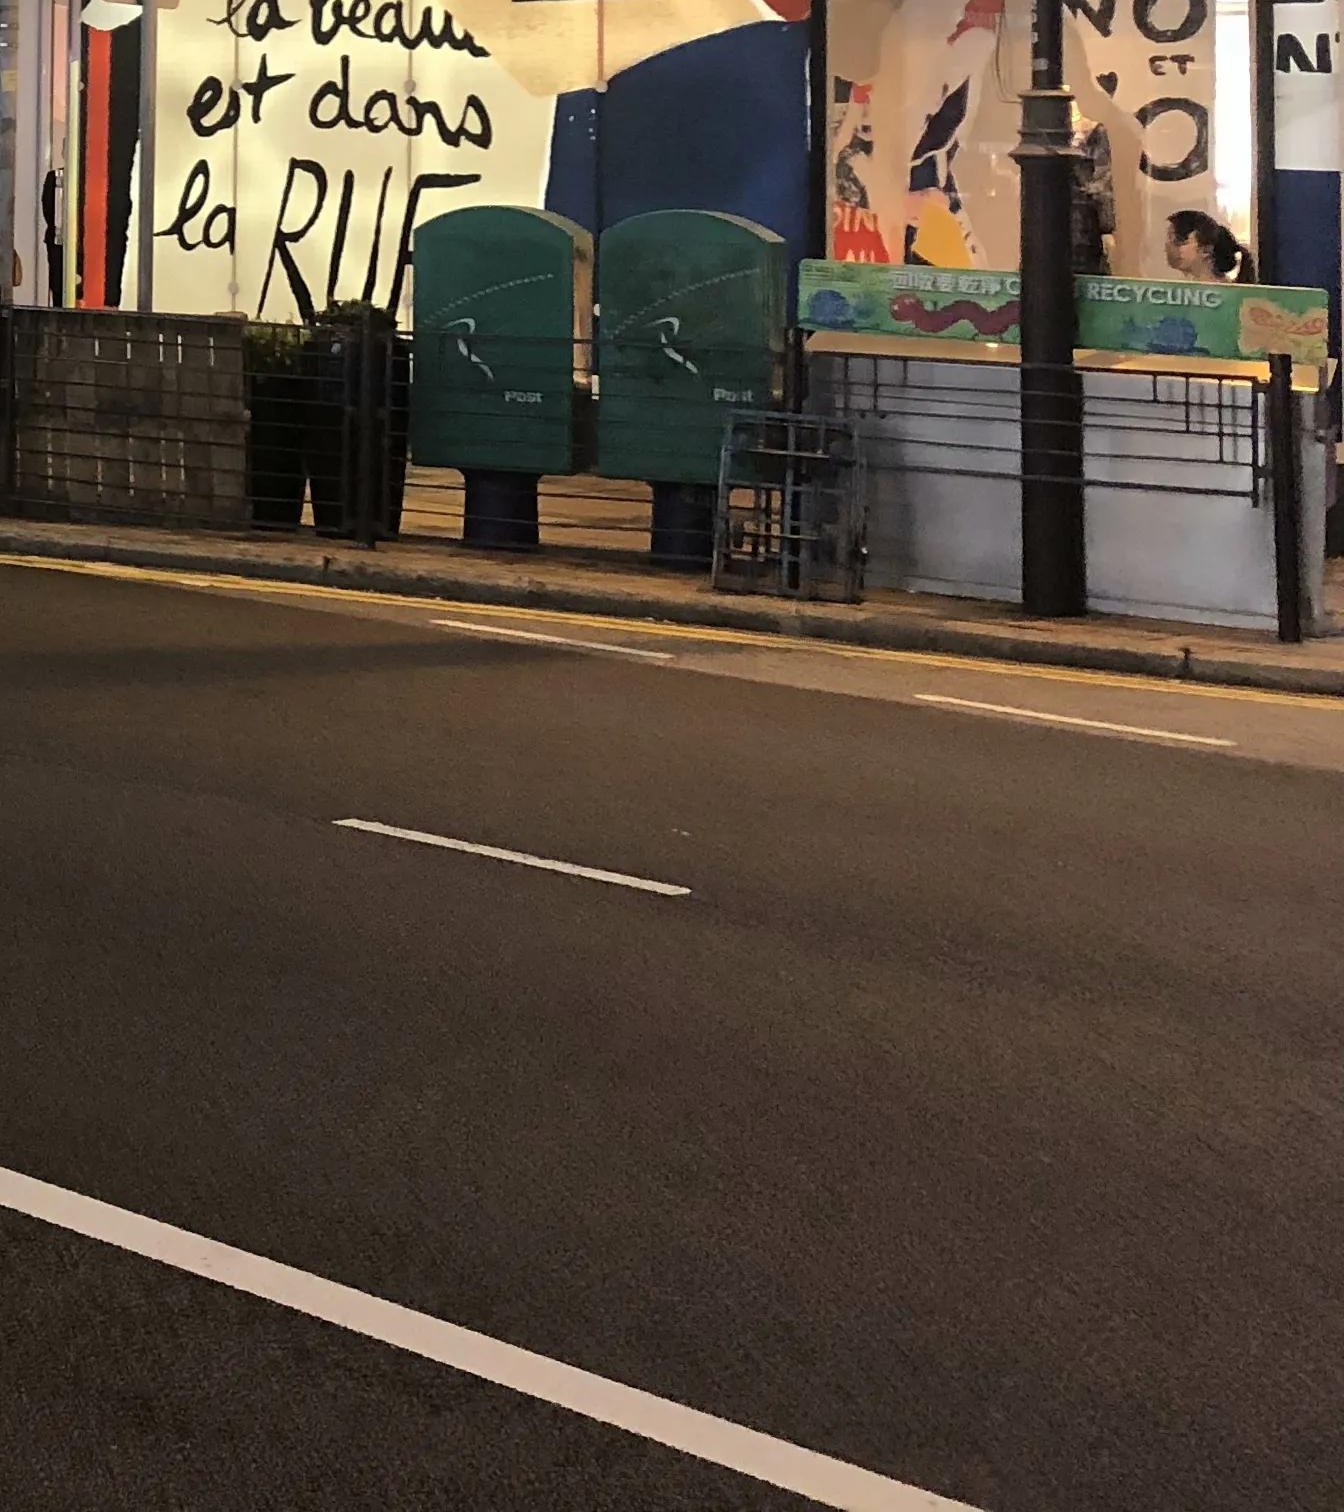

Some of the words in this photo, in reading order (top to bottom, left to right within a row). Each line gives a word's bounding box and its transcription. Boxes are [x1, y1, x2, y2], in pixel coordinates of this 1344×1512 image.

[187, 53, 295, 137] est
[308, 54, 492, 148] dans
[153, 159, 236, 255] la
[1086, 281, 1223, 309] RECYCLING
